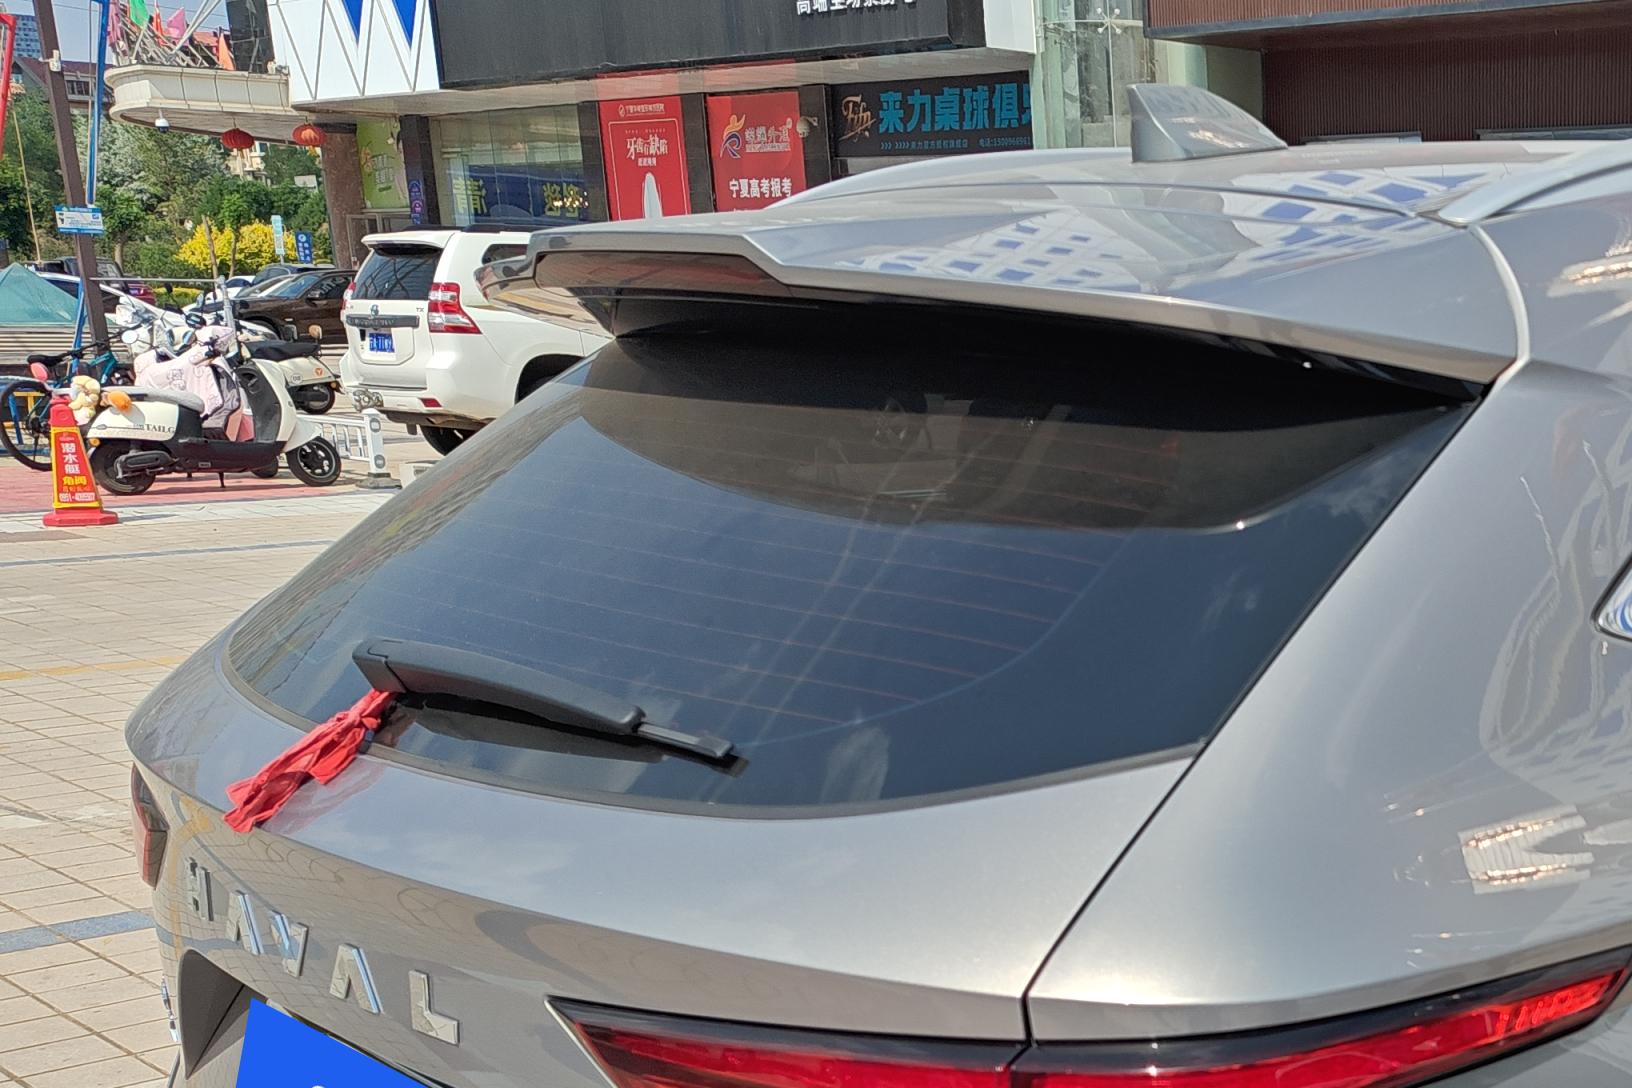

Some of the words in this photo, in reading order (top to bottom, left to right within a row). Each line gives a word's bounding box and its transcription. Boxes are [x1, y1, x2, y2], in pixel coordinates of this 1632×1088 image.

[728, 176, 793, 199] 宁夏高考报考
[184, 857, 462, 1046] HAVAL
